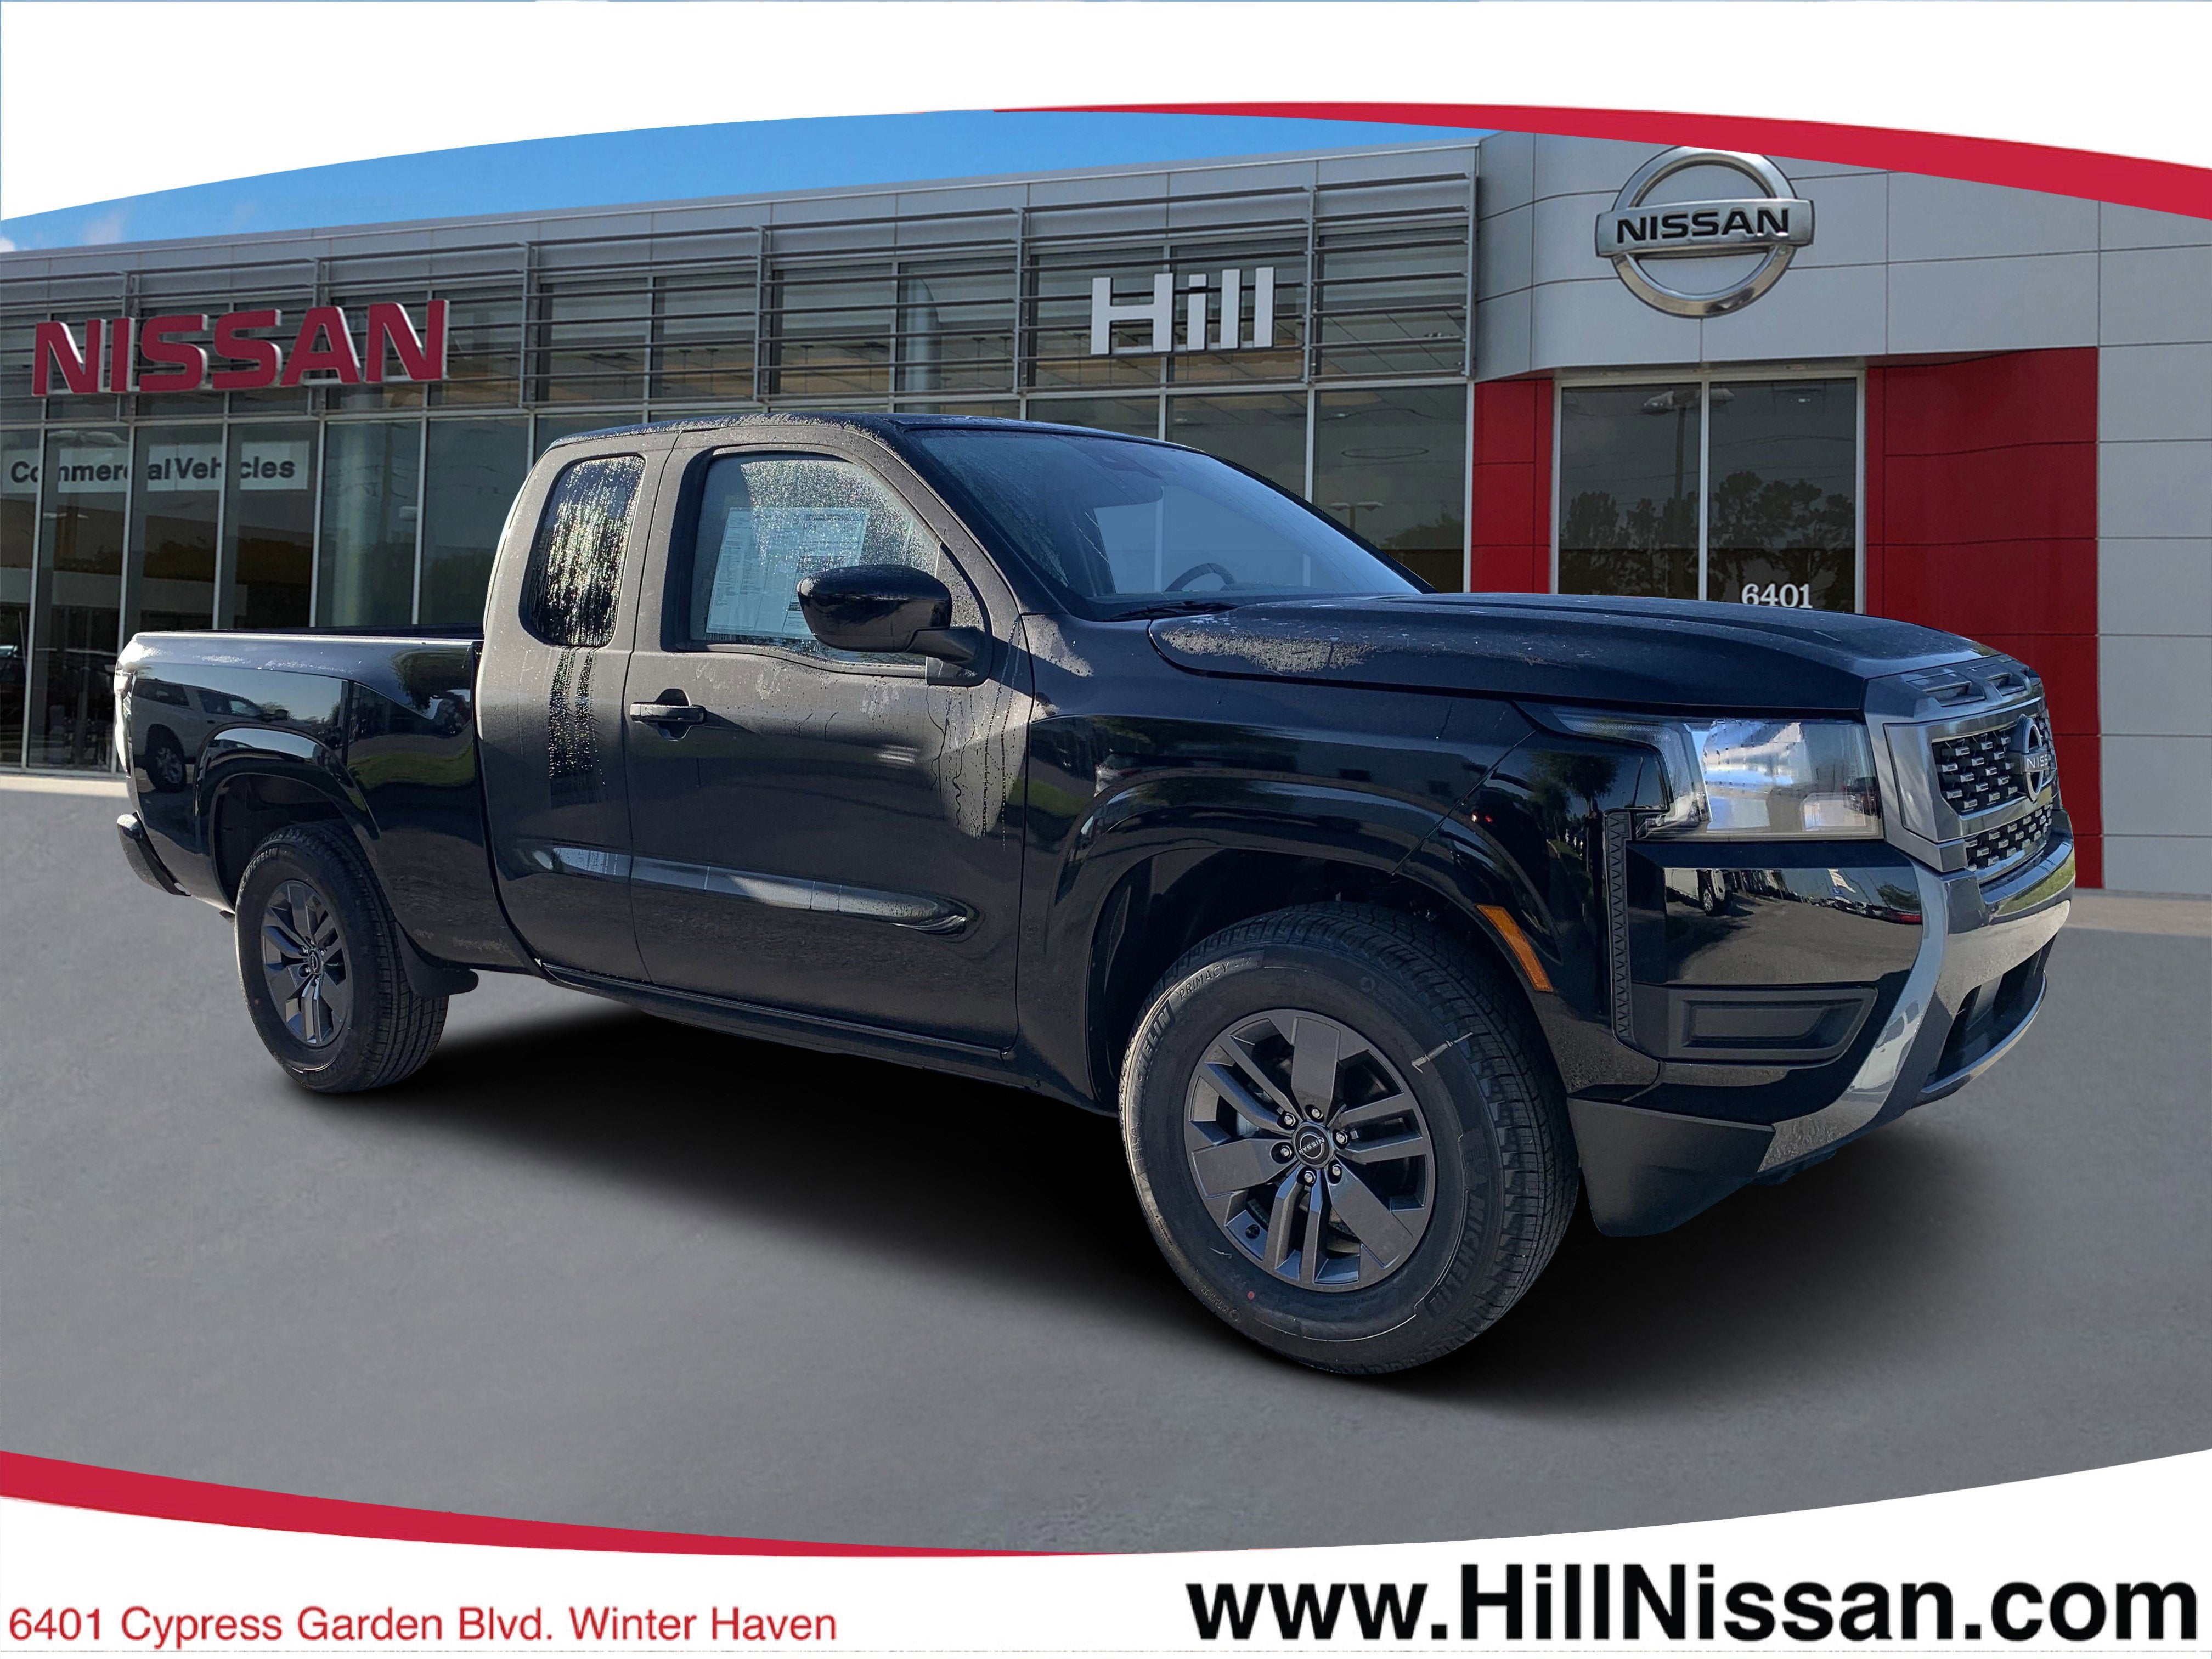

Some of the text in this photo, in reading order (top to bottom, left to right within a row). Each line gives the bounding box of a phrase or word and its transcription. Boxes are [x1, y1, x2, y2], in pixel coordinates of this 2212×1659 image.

[1617, 207, 1790, 244] NISSAN
[1090, 267, 1275, 355] Hill
[32, 300, 449, 397] NISSAN
[10, 456, 296, 483] Commeral Vehcles
[1741, 583, 1813, 608] 6401
[2027, 754, 2049, 769] NISS
[1179, 961, 1230, 1001] PRIMACY
[1298, 1136, 1325, 1155] NISSAN
